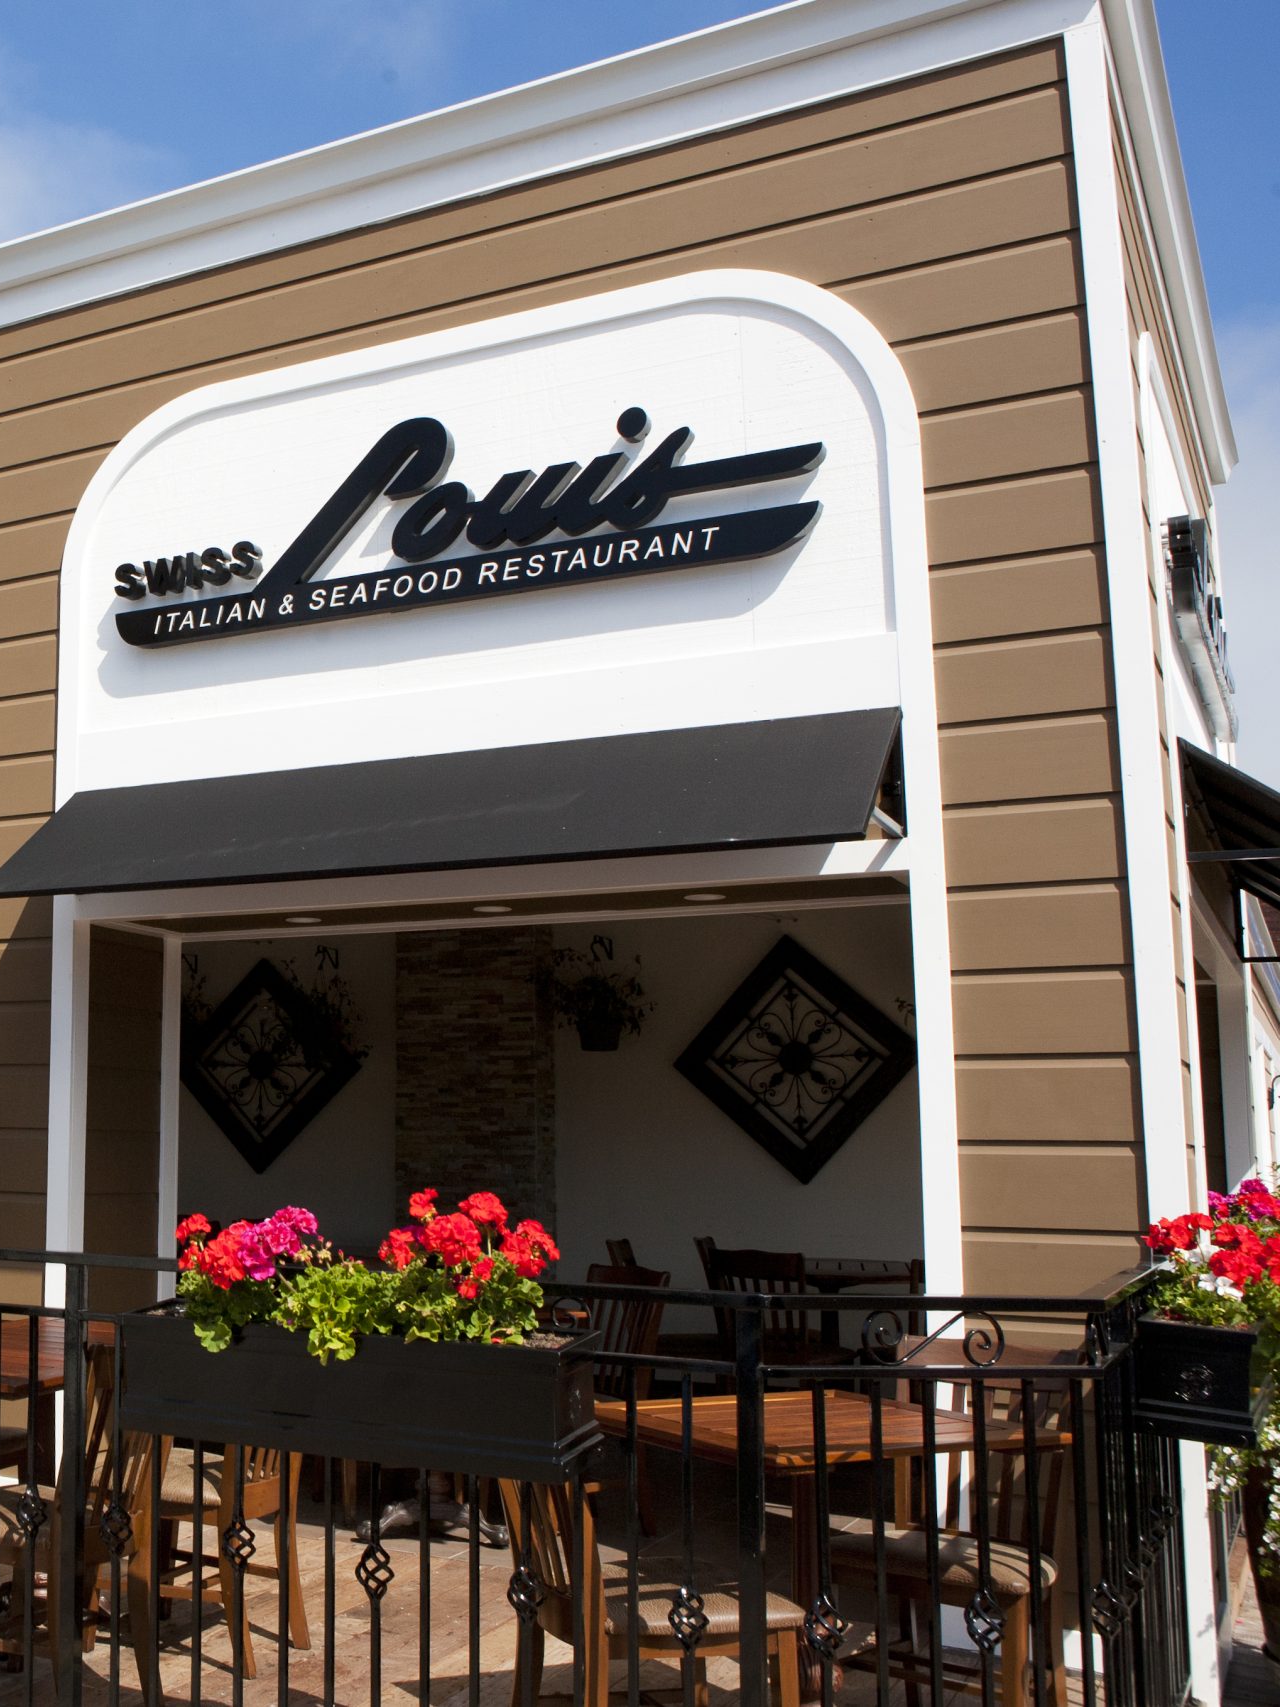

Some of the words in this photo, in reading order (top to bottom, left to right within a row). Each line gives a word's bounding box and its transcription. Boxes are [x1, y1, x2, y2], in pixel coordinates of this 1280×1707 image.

[252, 406, 827, 592] Louis
[114, 540, 264, 601] SWISS
[154, 598, 266, 635] ITALIAN
[278, 594, 294, 616] &
[309, 568, 463, 611] SEAFOOD
[477, 526, 720, 585] RESTAURANT
